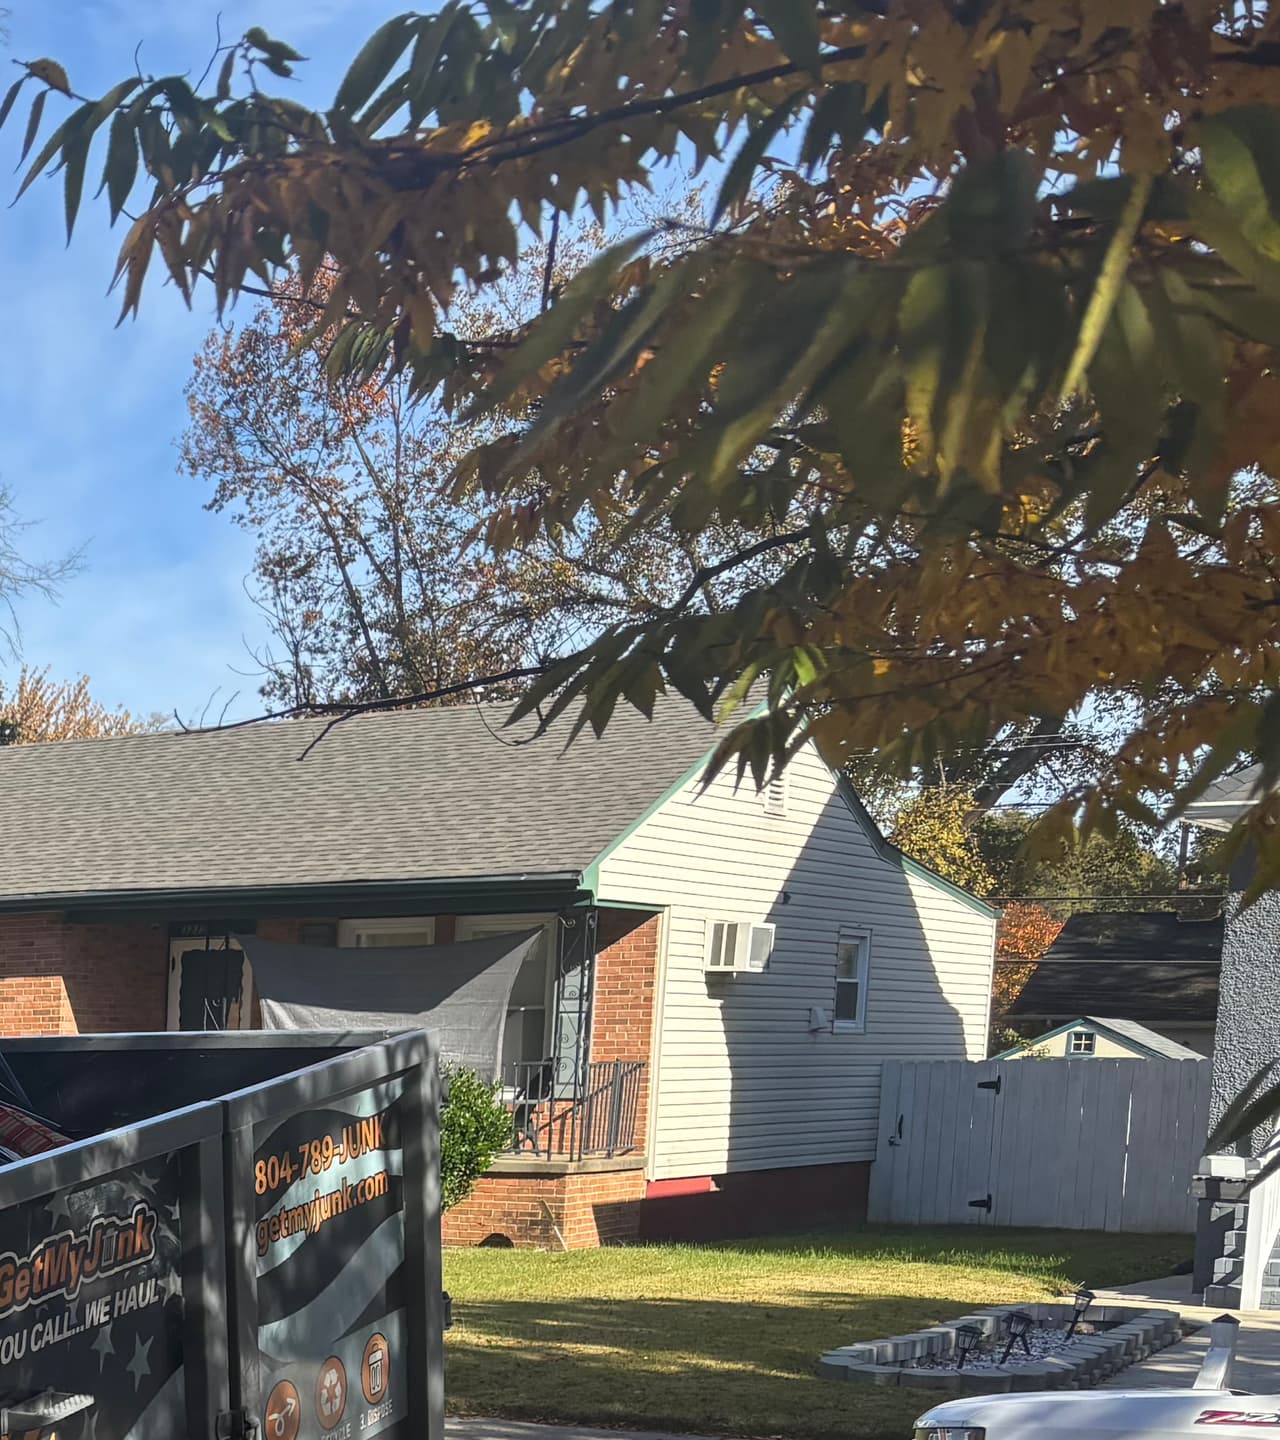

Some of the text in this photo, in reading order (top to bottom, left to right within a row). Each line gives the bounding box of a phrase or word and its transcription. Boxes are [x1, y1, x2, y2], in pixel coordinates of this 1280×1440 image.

[255, 1113, 386, 1195] 804-789-JUNK
[256, 1169, 389, 1257] getmyjunk.com
[114, 1278, 159, 1318] HAUL
[1194, 1410, 1280, 1426] Z7
